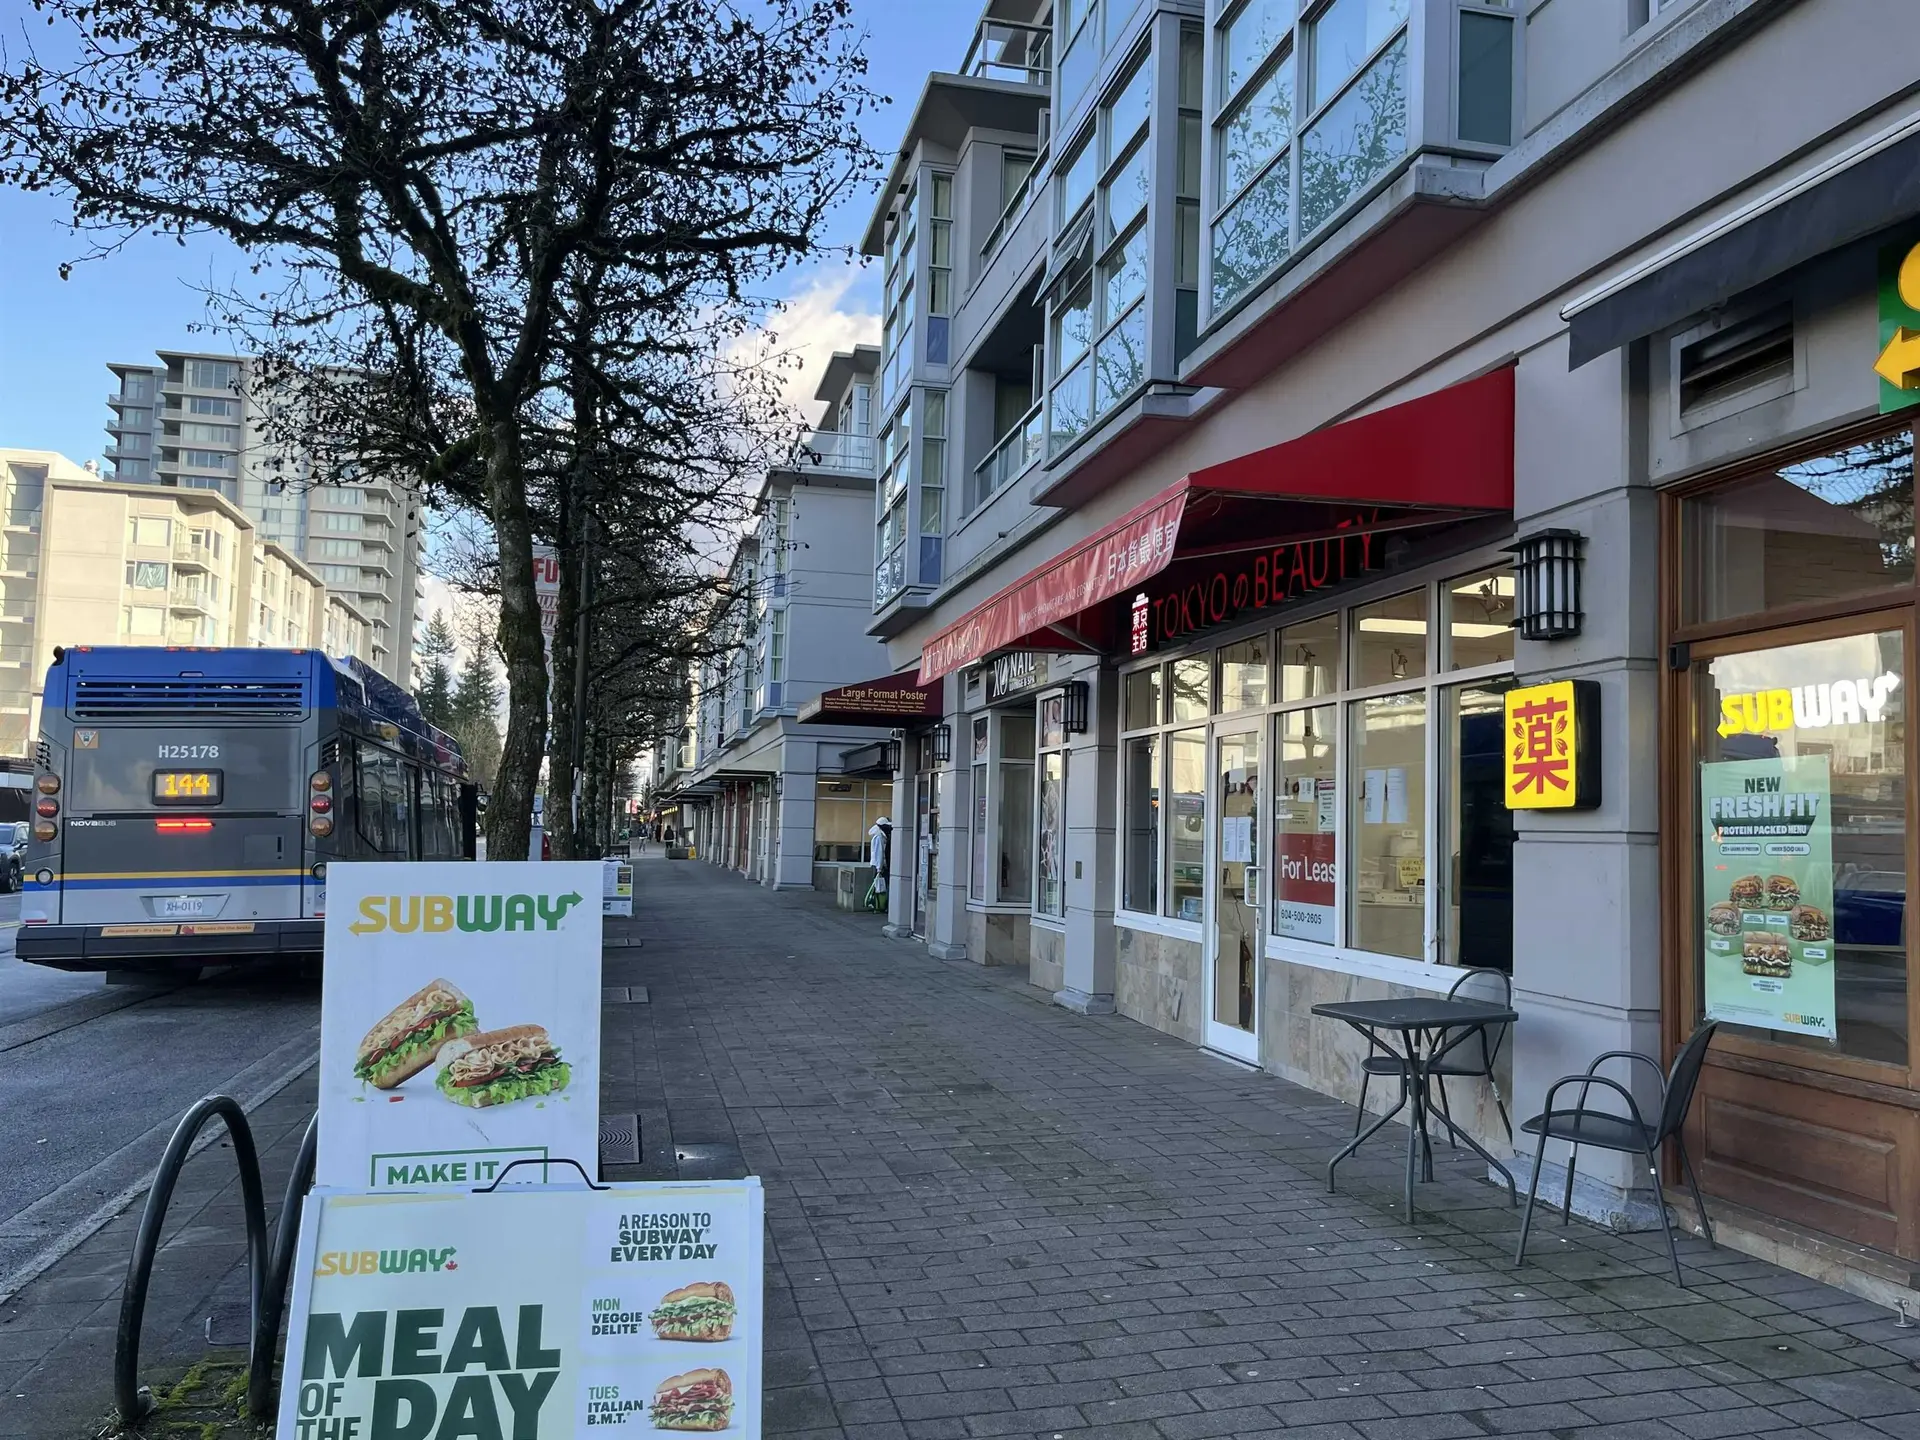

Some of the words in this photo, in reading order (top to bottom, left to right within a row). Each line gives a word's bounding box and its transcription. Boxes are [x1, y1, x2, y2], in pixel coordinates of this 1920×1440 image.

[1108, 520, 1175, 581] 日本貨最便宜
[1153, 571, 1227, 641] TOKYO
[1254, 508, 1380, 609] BEAUTY
[1010, 652, 1034, 678] NAIL
[841, 688, 866, 699] Large
[868, 688, 898, 699] Format
[900, 690, 928, 700] Poster
[1717, 670, 1899, 738] SUBWAY
[158, 745, 219, 758] H25178
[165, 774, 210, 796] 144
[1744, 777, 1781, 793] NEW
[1709, 794, 1780, 819] FRESH
[1783, 792, 1820, 817] FIT
[1718, 825, 1753, 836] PROTEIN
[1754, 825, 1787, 835] PACKED
[1788, 825, 1807, 834] MENU
[1281, 855, 1301, 880] For
[1304, 856, 1336, 883] Leas
[348, 890, 584, 937] SUBWAY
[1281, 908, 1322, 924] 604-500-2605
[1783, 1012, 1826, 1028] SUBWAY
[388, 1162, 467, 1185] MAKE
[475, 1161, 499, 1181] IT
[619, 1215, 627, 1230] A
[631, 1213, 692, 1229] REASON
[693, 1212, 711, 1228] TO
[315, 1246, 457, 1278] SUBWAY
[611, 1245, 676, 1262] EVERY
[679, 1244, 718, 1259] DAY
[592, 1298, 620, 1311] MON
[592, 1312, 643, 1324] VEGGIE
[591, 1324, 639, 1336] DELITE
[302, 1304, 561, 1380] MEAL
[299, 1382, 344, 1418] OF
[588, 1386, 619, 1400] TUES
[371, 1371, 561, 1440] DAY
[588, 1400, 644, 1413] ITALIAN
[297, 1416, 361, 1440] THE
[587, 1413, 627, 1426] B.M.T.
